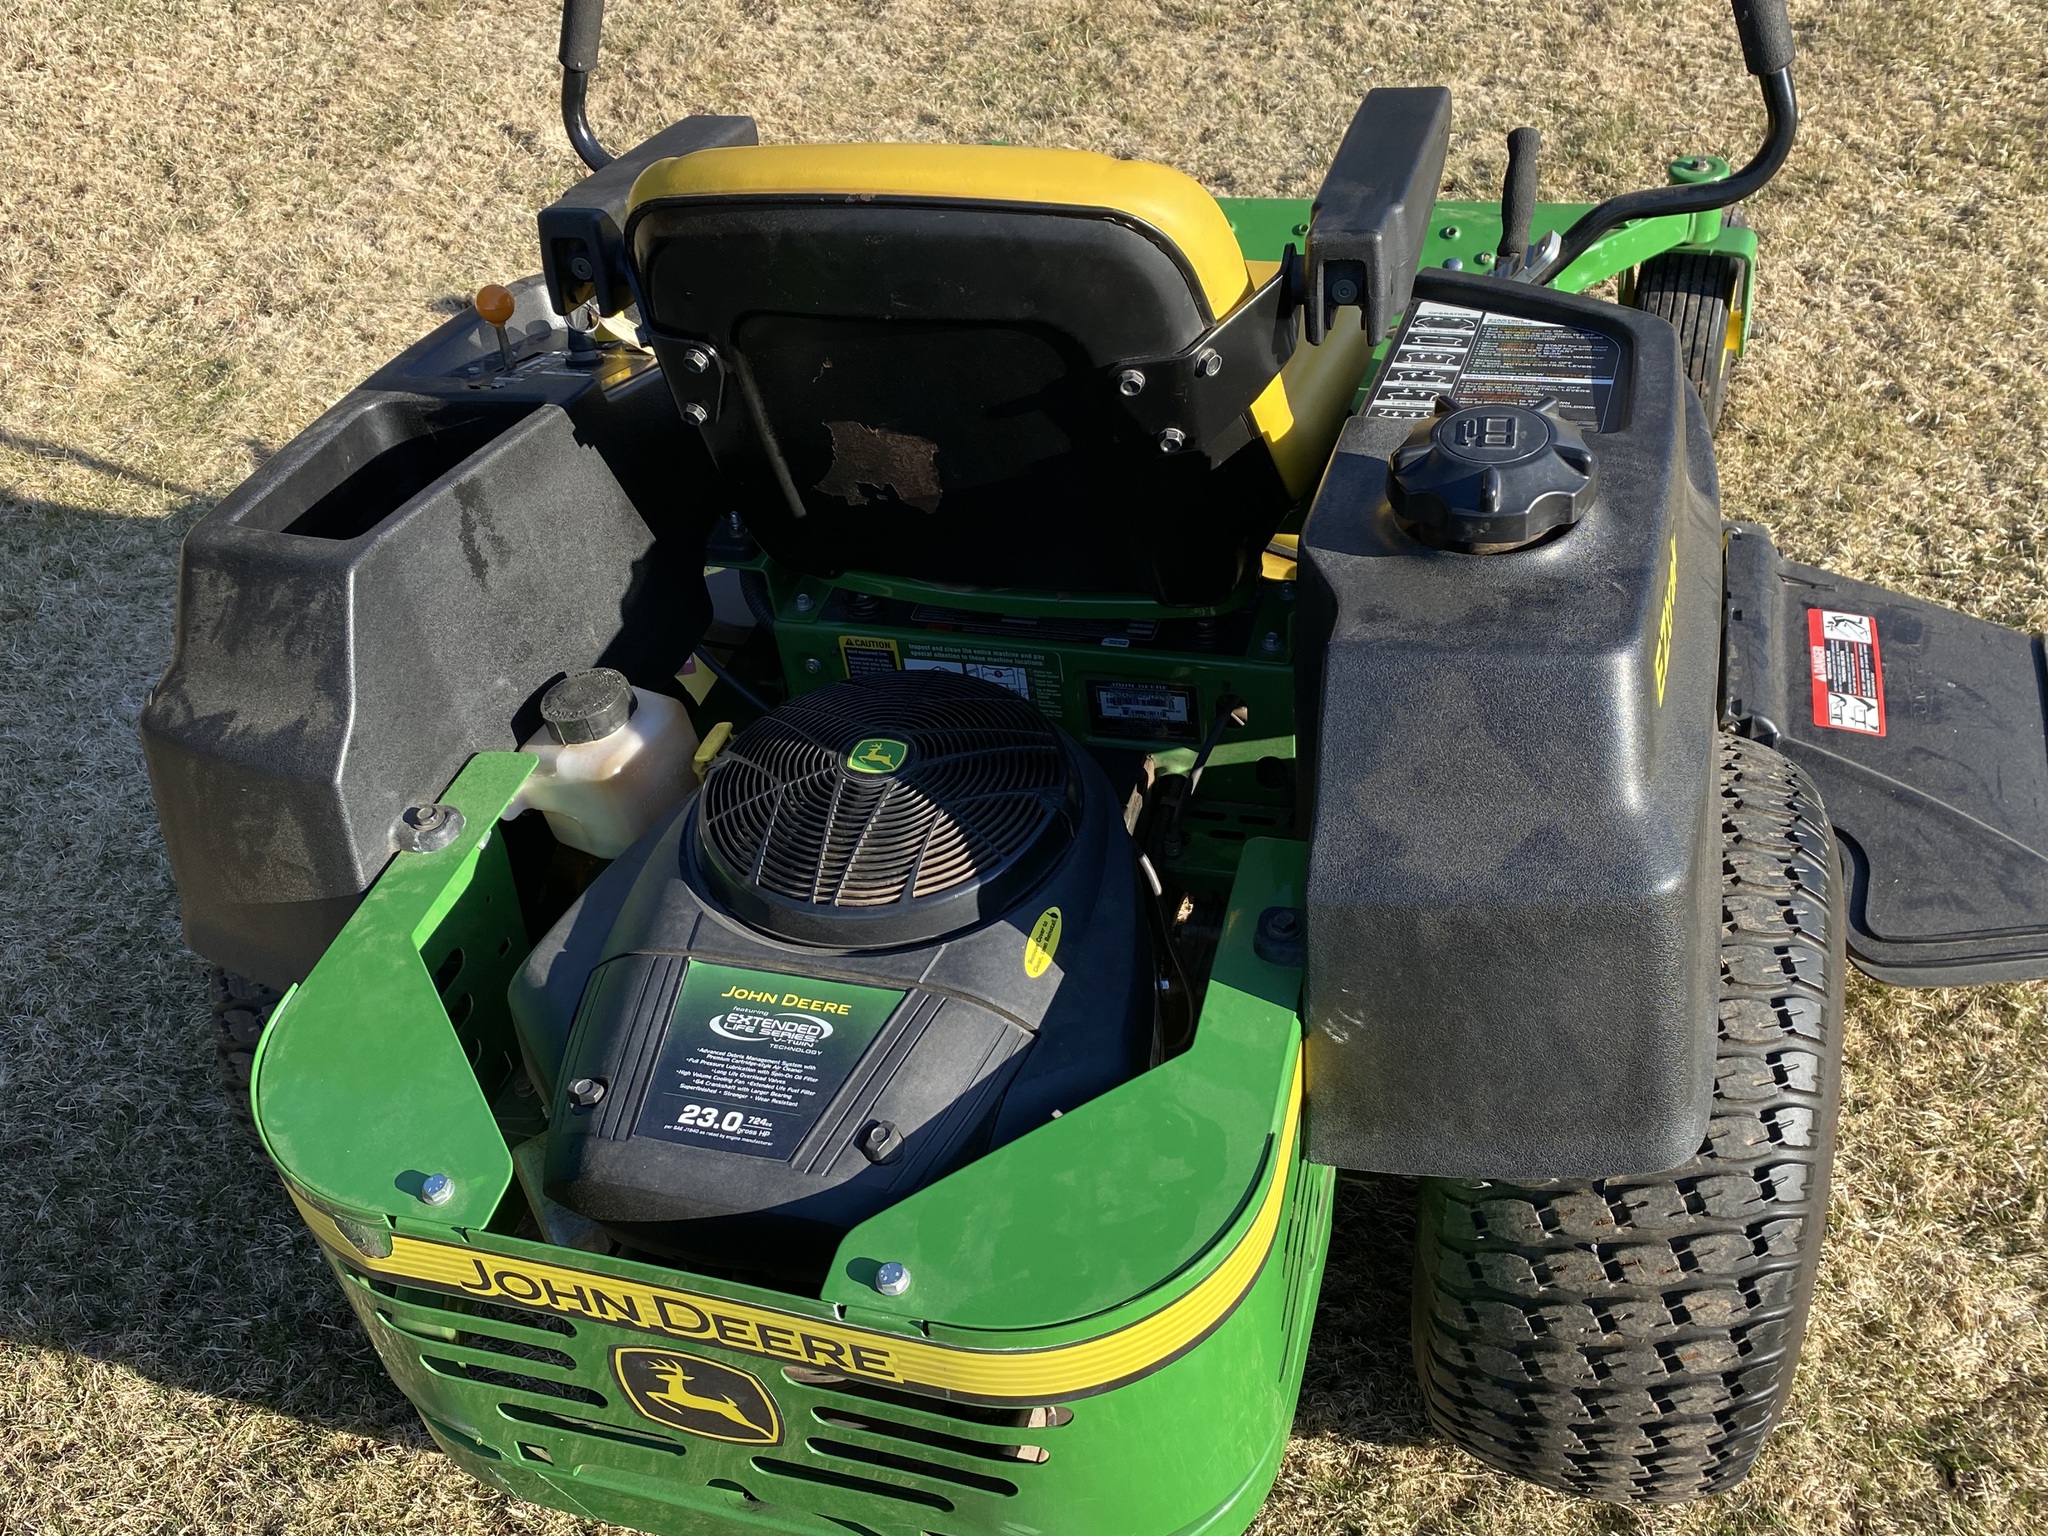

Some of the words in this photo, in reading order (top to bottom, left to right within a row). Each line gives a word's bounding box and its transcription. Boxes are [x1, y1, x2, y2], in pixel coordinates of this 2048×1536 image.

[855, 640, 891, 649] CAUTION
[1812, 646, 1826, 674] DANGER
[1036, 927, 1046, 943] Cover
[721, 986, 778, 1004] JOHN
[781, 994, 852, 1016] DEERE
[732, 1006, 770, 1016] featuring
[723, 1022, 756, 1034] LIFE
[726, 1012, 821, 1036] EXTENDED
[770, 1043, 823, 1056] TECHNOLOGY
[773, 1036, 814, 1048] V-TWIN
[699, 1048, 726, 1056] Advanced
[727, 1051, 744, 1059] Debris
[746, 1055, 781, 1065] Management
[781, 1060, 802, 1068] System
[706, 1054, 730, 1062] Premium
[782, 1065, 803, 1073] Cleaner
[700, 1059, 724, 1068] Pressure
[726, 1063, 756, 1073] Lubrication
[770, 1070, 793, 1079] Spin-On
[705, 1080, 736, 1090] Crankshaft
[750, 1088, 770, 1096] Larger
[770, 1091, 792, 1100] Bearing
[712, 1075, 733, 1084] Cooling
[750, 1081, 776, 1090] Extended
[680, 1083, 718, 1094] Superfinished
[723, 1091, 748, 1100] Stronger
[771, 1098, 799, 1107] Resistant
[678, 1104, 744, 1132] 23.0
[737, 1127, 758, 1136] gross
[758, 1129, 771, 1137] HP
[742, 1137, 774, 1146] manufacturer
[460, 1258, 643, 1324] JOHN
[652, 1295, 896, 1378] DEERE
